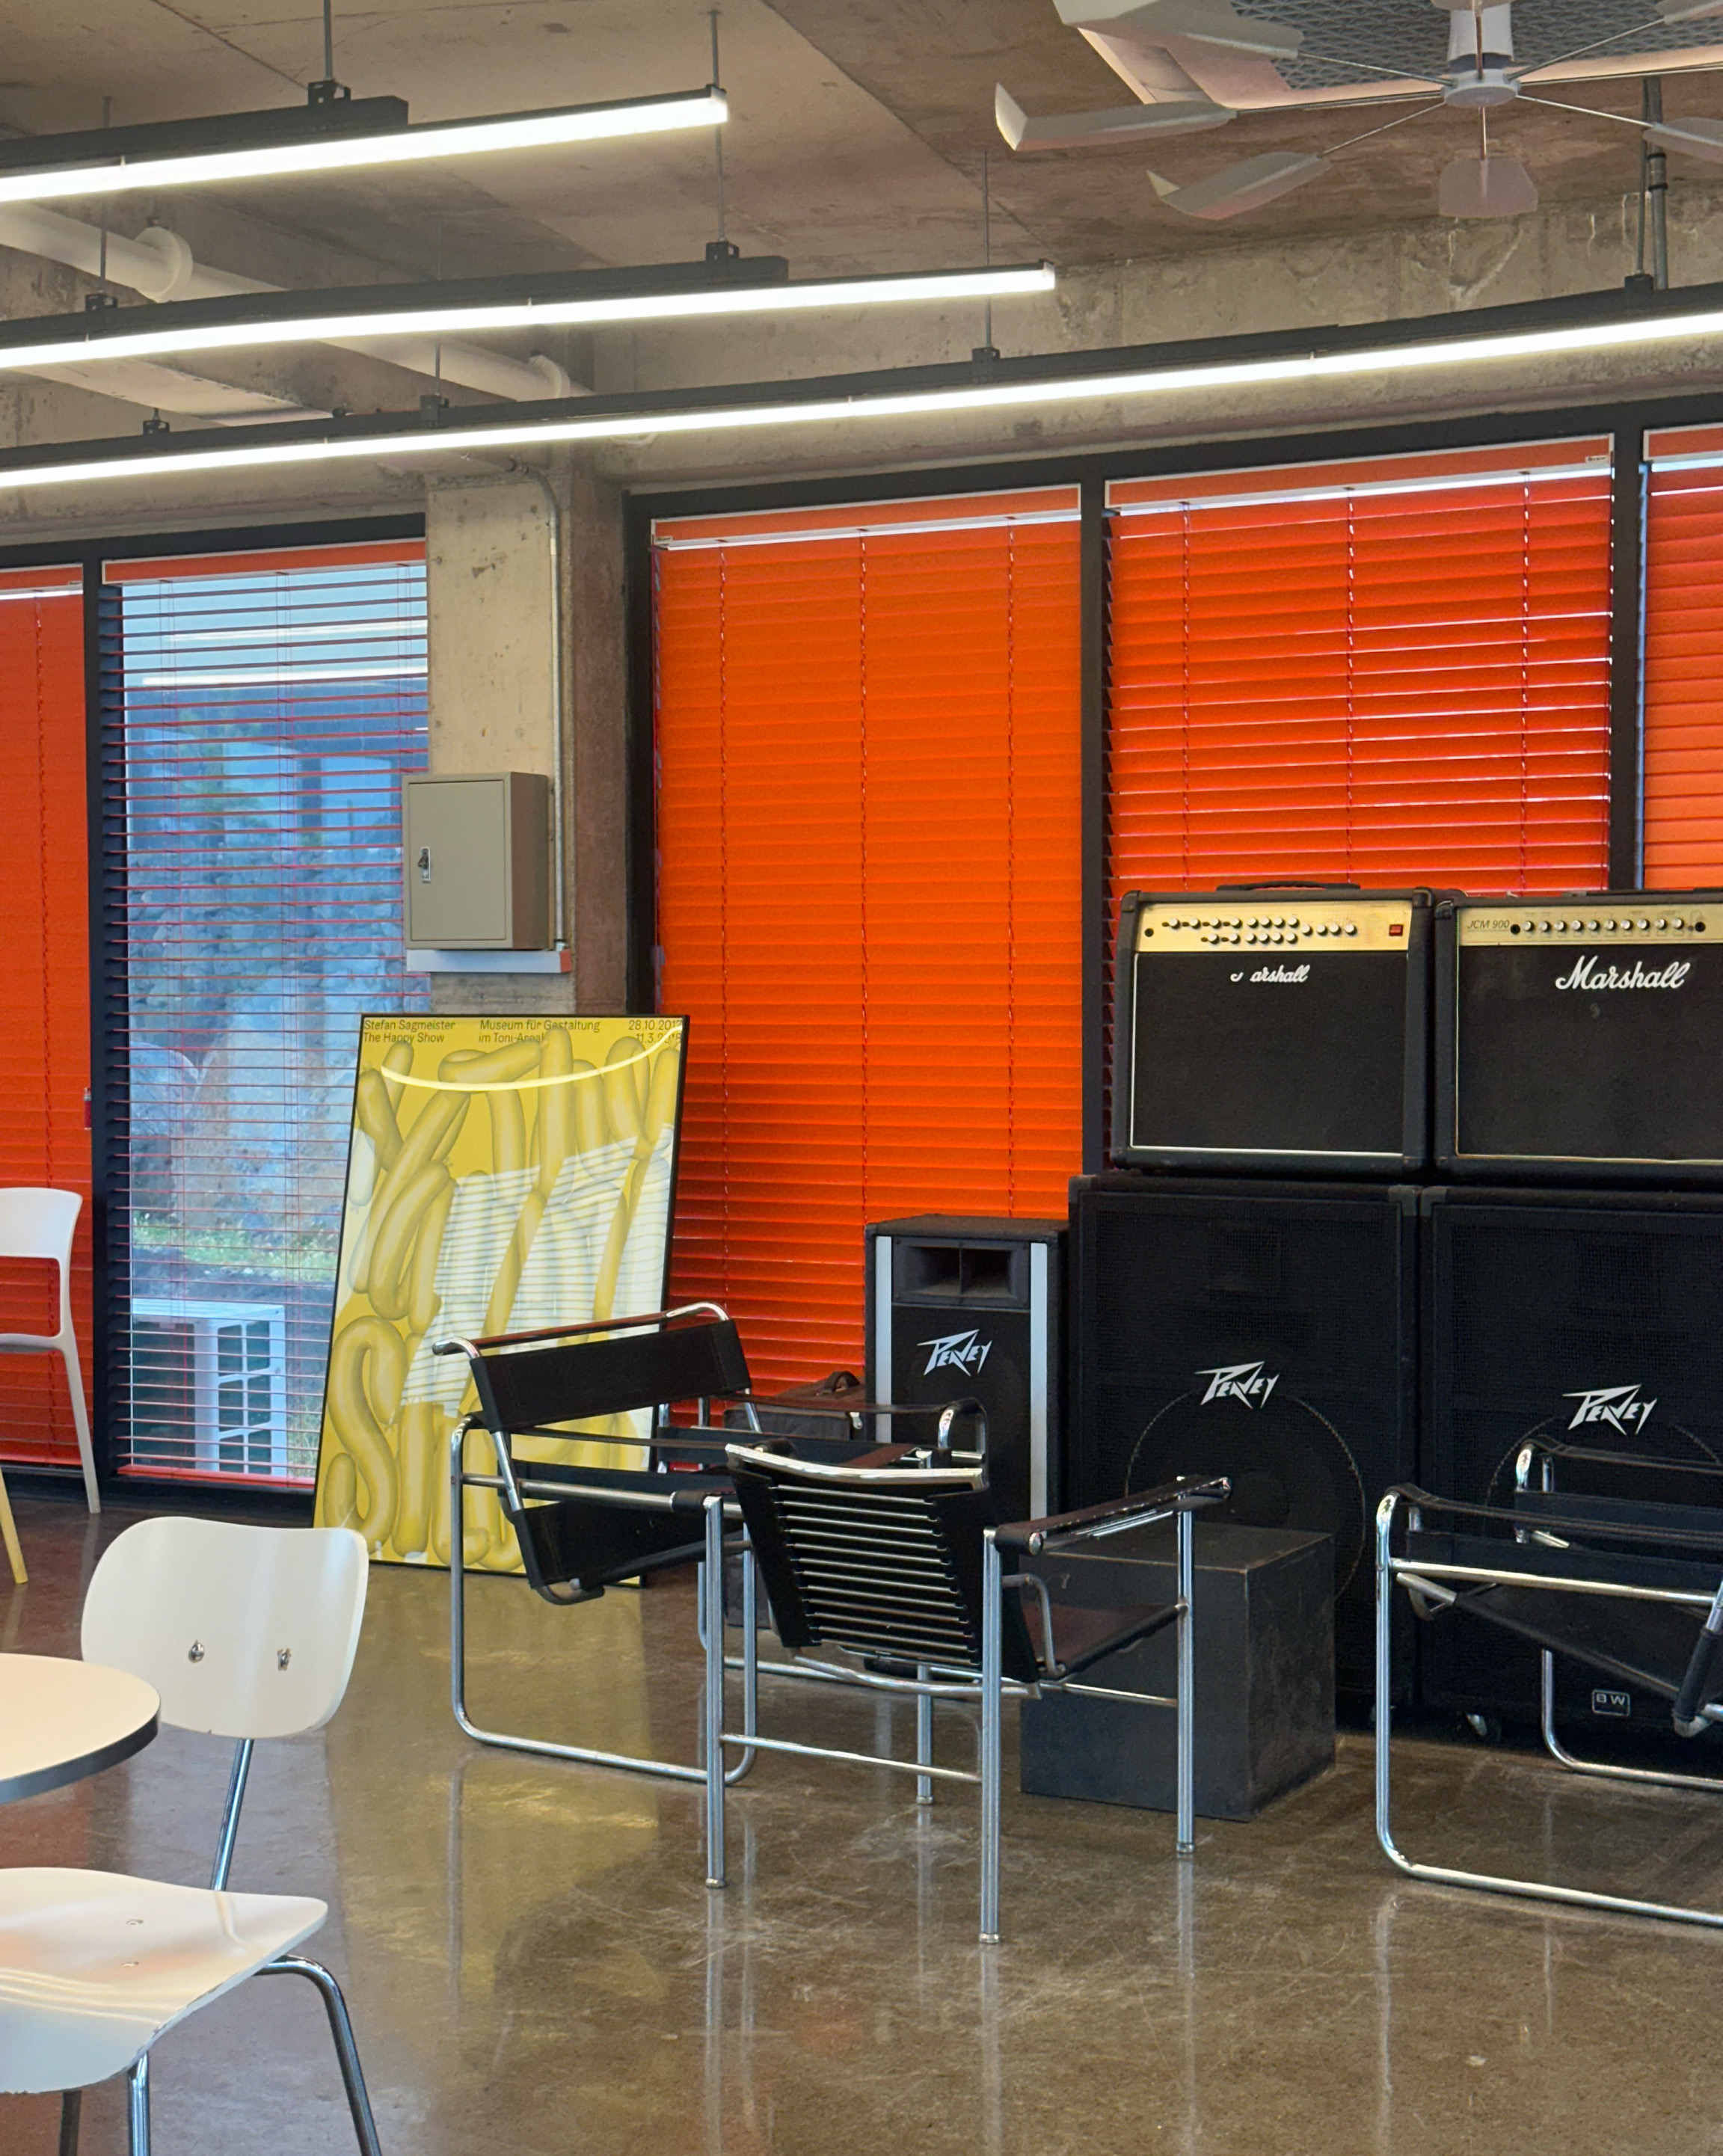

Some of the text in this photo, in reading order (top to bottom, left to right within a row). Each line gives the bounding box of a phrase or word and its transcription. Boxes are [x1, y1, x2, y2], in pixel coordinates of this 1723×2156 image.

[1466, 920, 1510, 929] JCM 900
[1230, 965, 1311, 983] arshall
[1555, 955, 1691, 990] Marshall
[364, 1019, 456, 1033] Stefan Sagmeister
[480, 1019, 601, 1034] Museum für Gestaltung
[363, 1032, 445, 1044] The Happy Show
[479, 1033, 491, 1043] im
